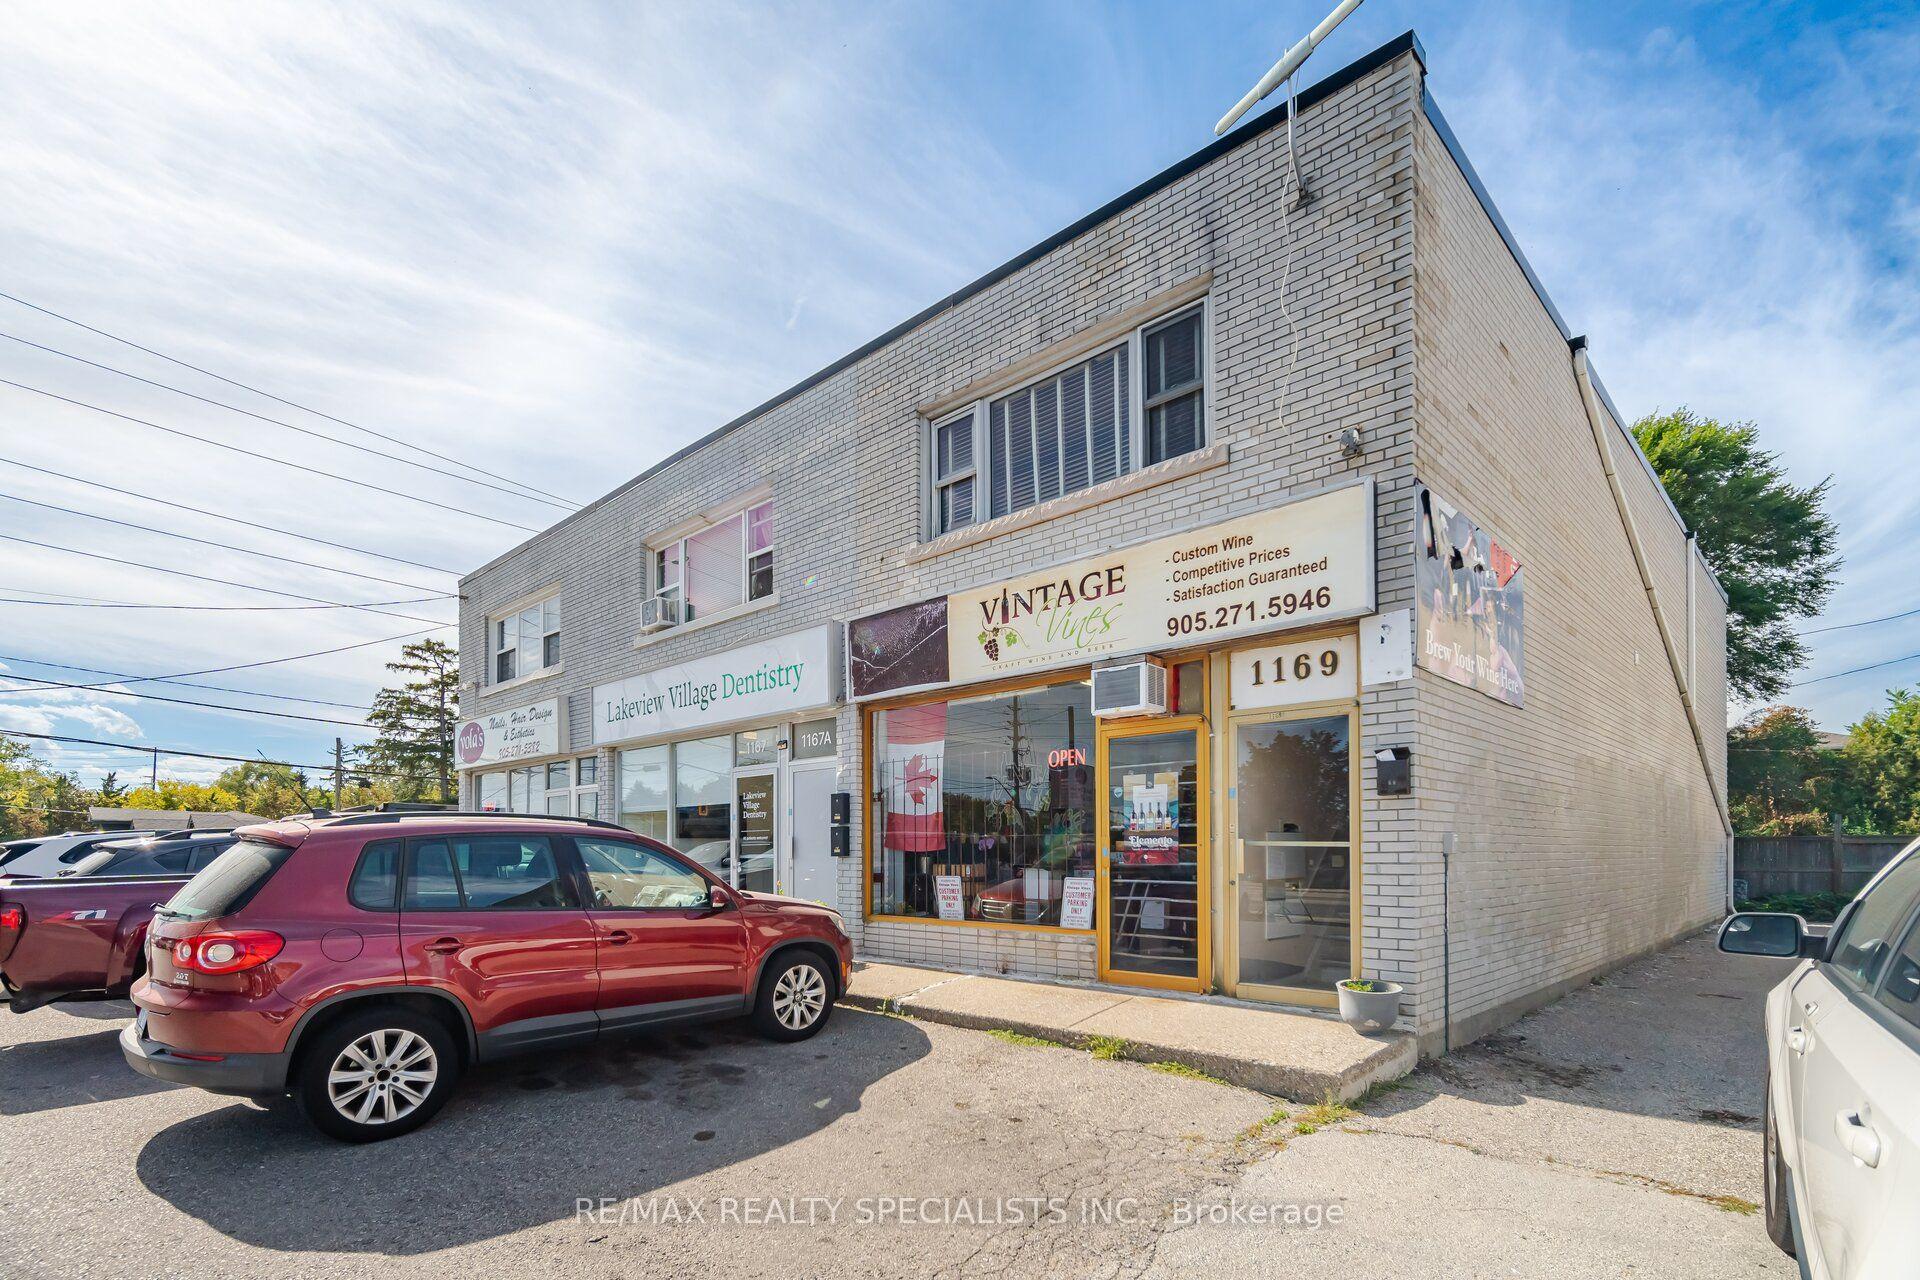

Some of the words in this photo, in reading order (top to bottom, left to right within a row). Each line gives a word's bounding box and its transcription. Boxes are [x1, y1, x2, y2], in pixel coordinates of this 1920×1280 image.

[1172, 543, 1218, 564] Custom
[1222, 535, 1254, 551] Wine
[1172, 557, 1245, 583] Competitive
[1249, 547, 1290, 566] Prices
[1173, 578, 1244, 603] Satisfaction
[1249, 557, 1328, 586] Guaranteed
[979, 565, 1127, 625] VINTAGE
[1036, 597, 1124, 649] Vines
[1167, 586, 1331, 637] 905.271.5946
[992, 661, 1021, 671] CRAFT
[1028, 656, 1052, 664] WINE
[1060, 650, 1080, 658] AND
[1087, 644, 1115, 653] BEER
[1251, 650, 1339, 686] 1169
[1425, 629, 1452, 662] Brew
[1453, 642, 1475, 674] Your
[1476, 654, 1500, 685] Wine
[1500, 667, 1519, 695] Here
[607, 693, 665, 723] Lakeview
[668, 681, 718, 711] Village
[722, 663, 804, 699] Dentistry
[528, 707, 553, 723] Design
[746, 740, 767, 755] 1167
[801, 730, 832, 748] 1167A
[1048, 748, 1086, 768] OPEN
[743, 791, 767, 800] Lakeview
[743, 801, 760, 811] Village
[743, 811, 767, 820] Dentistry
[1065, 891, 1092, 899] CUSTOMER
[1067, 899, 1088, 907] PARKING
